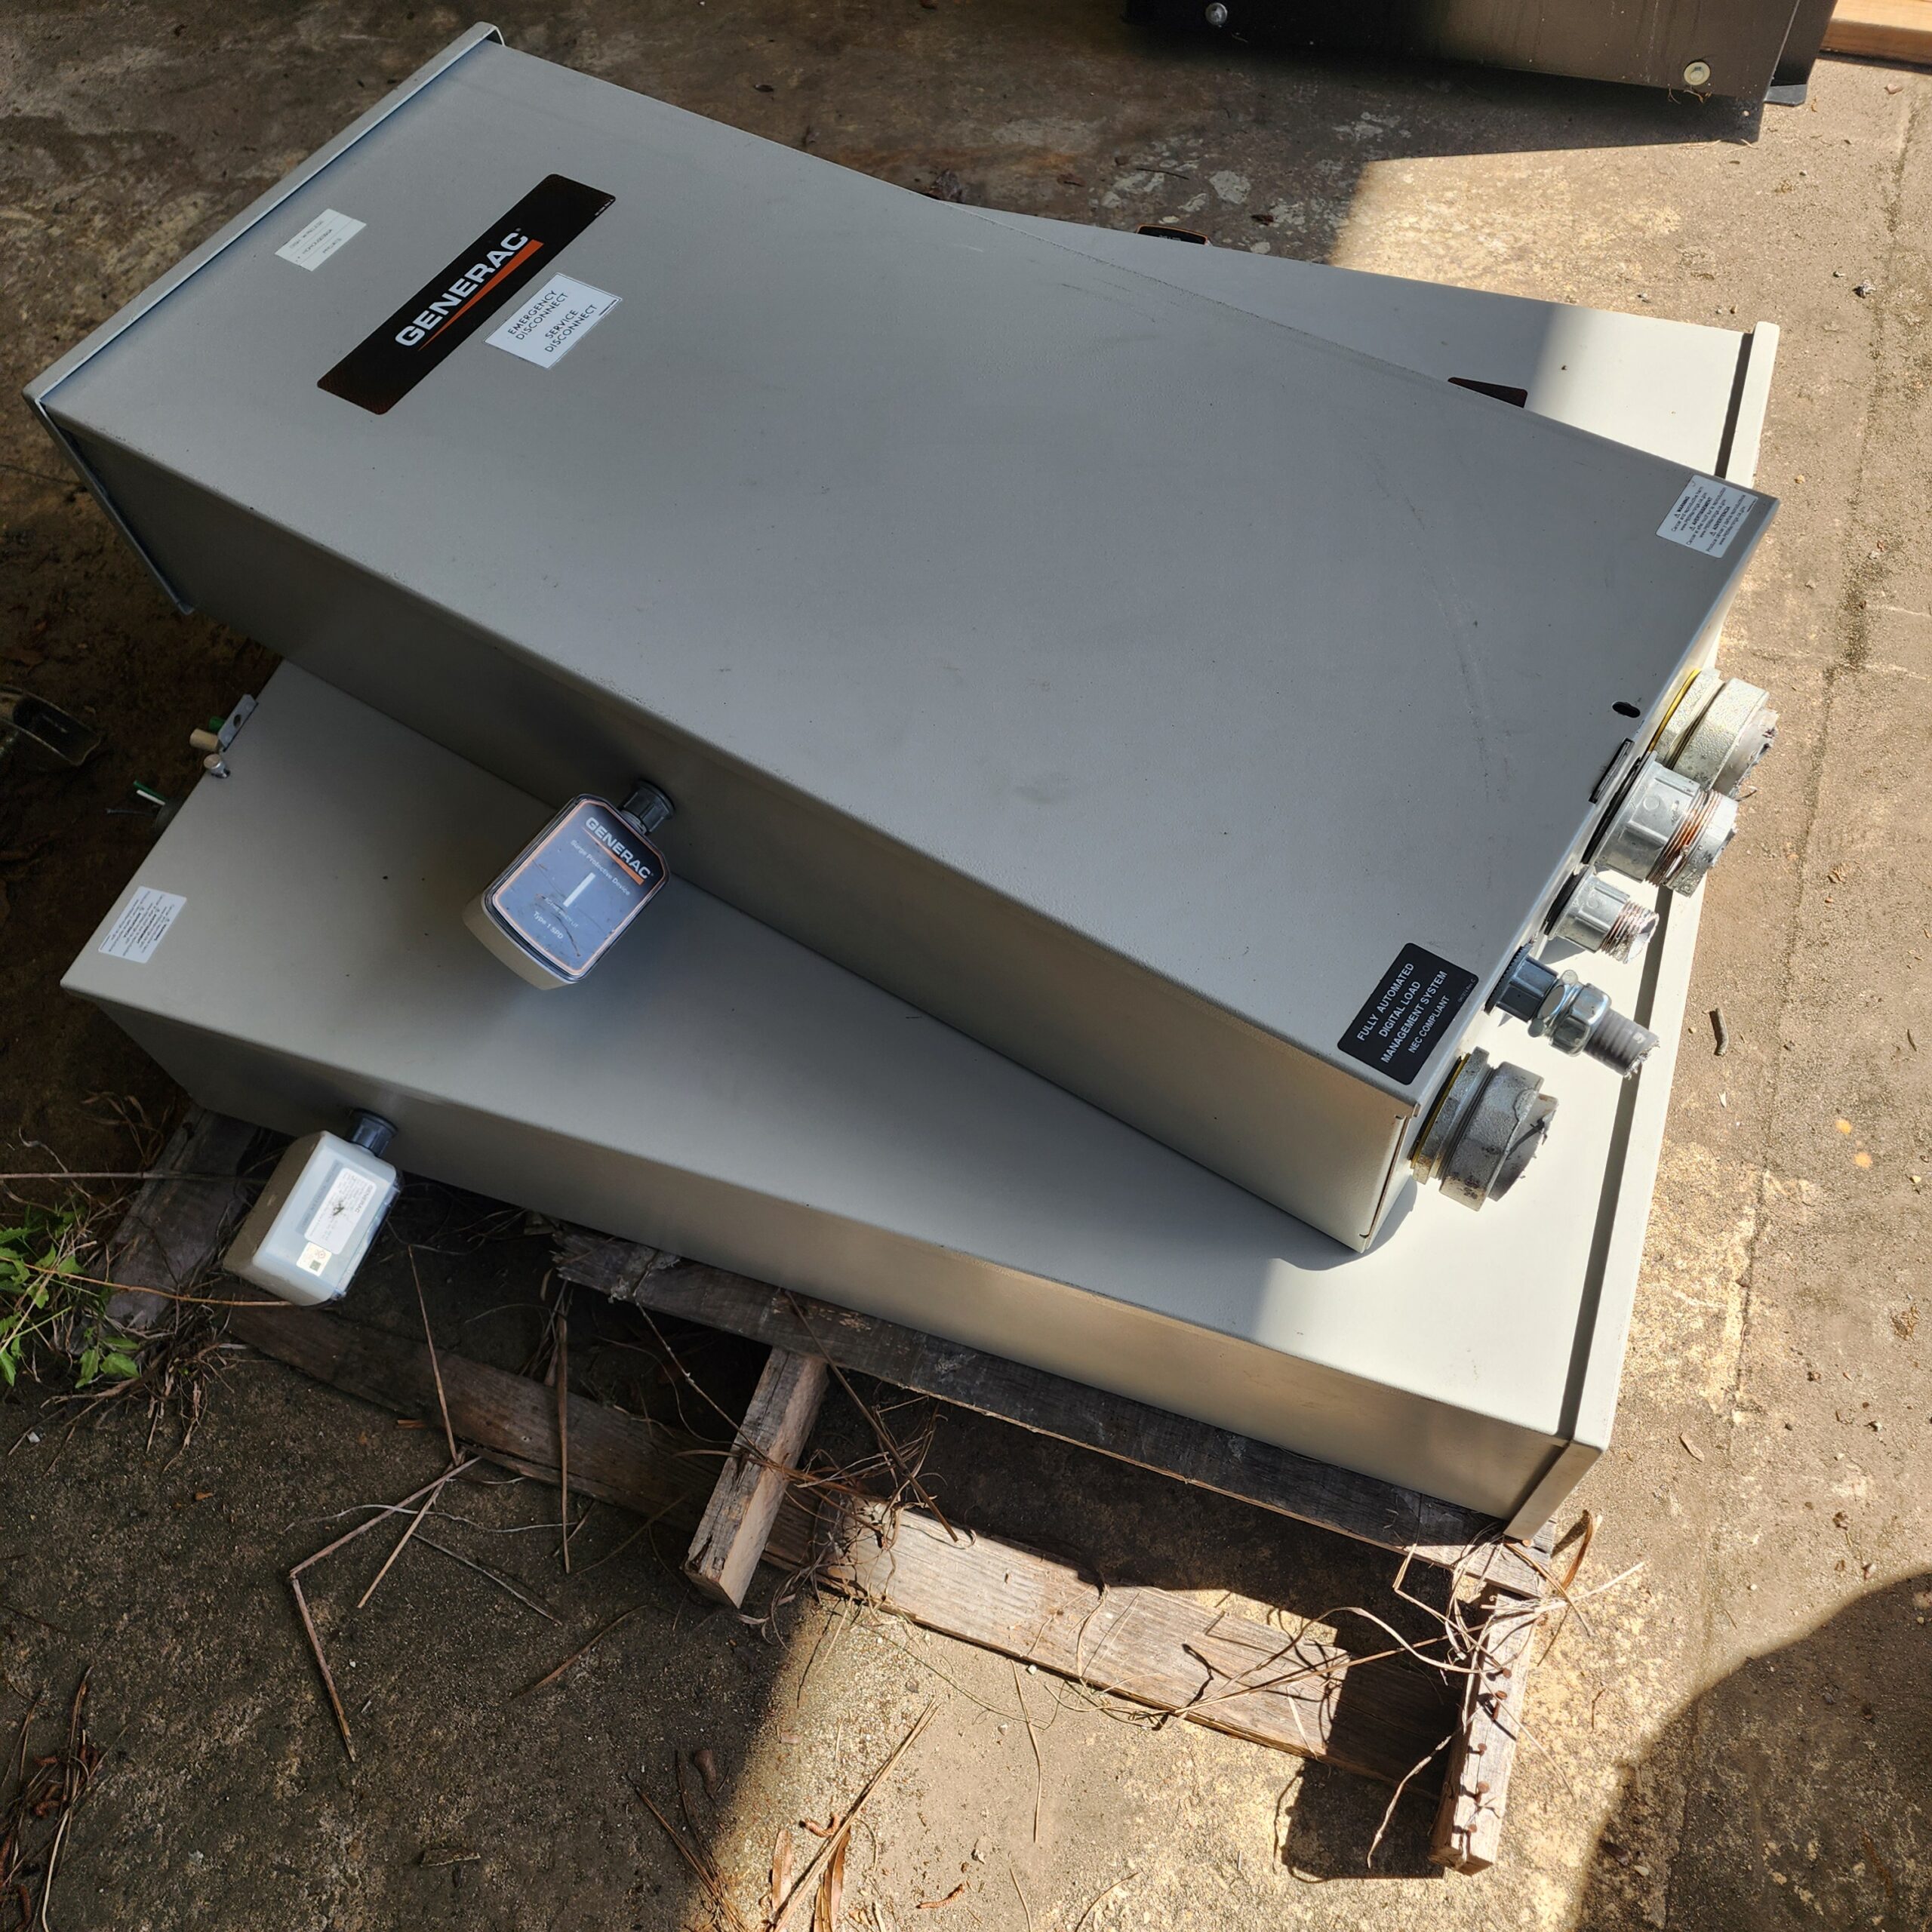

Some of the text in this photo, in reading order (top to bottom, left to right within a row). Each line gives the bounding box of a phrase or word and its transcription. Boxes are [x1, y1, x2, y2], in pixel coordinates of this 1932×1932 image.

[394, 229, 528, 347] GENERAC
[507, 290, 556, 334] EMERGENCY
[515, 292, 568, 340] DISCONNECT
[544, 309, 579, 338] SERVICE
[544, 303, 597, 352] DISCONNECT
[571, 839, 631, 896] Surge Protective Device
[584, 815, 652, 878] GENERAC
[533, 911, 546, 925] Type
[550, 927, 563, 940] SPD
[1356, 962, 1414, 1041] FULLY AUTOMATED
[1378, 980, 1421, 1037] DIGITAL LOAD
[1380, 970, 1447, 1063] MANAGEMENT SYSTEM
[1407, 995, 1450, 1053] NEC COMPLIANT
